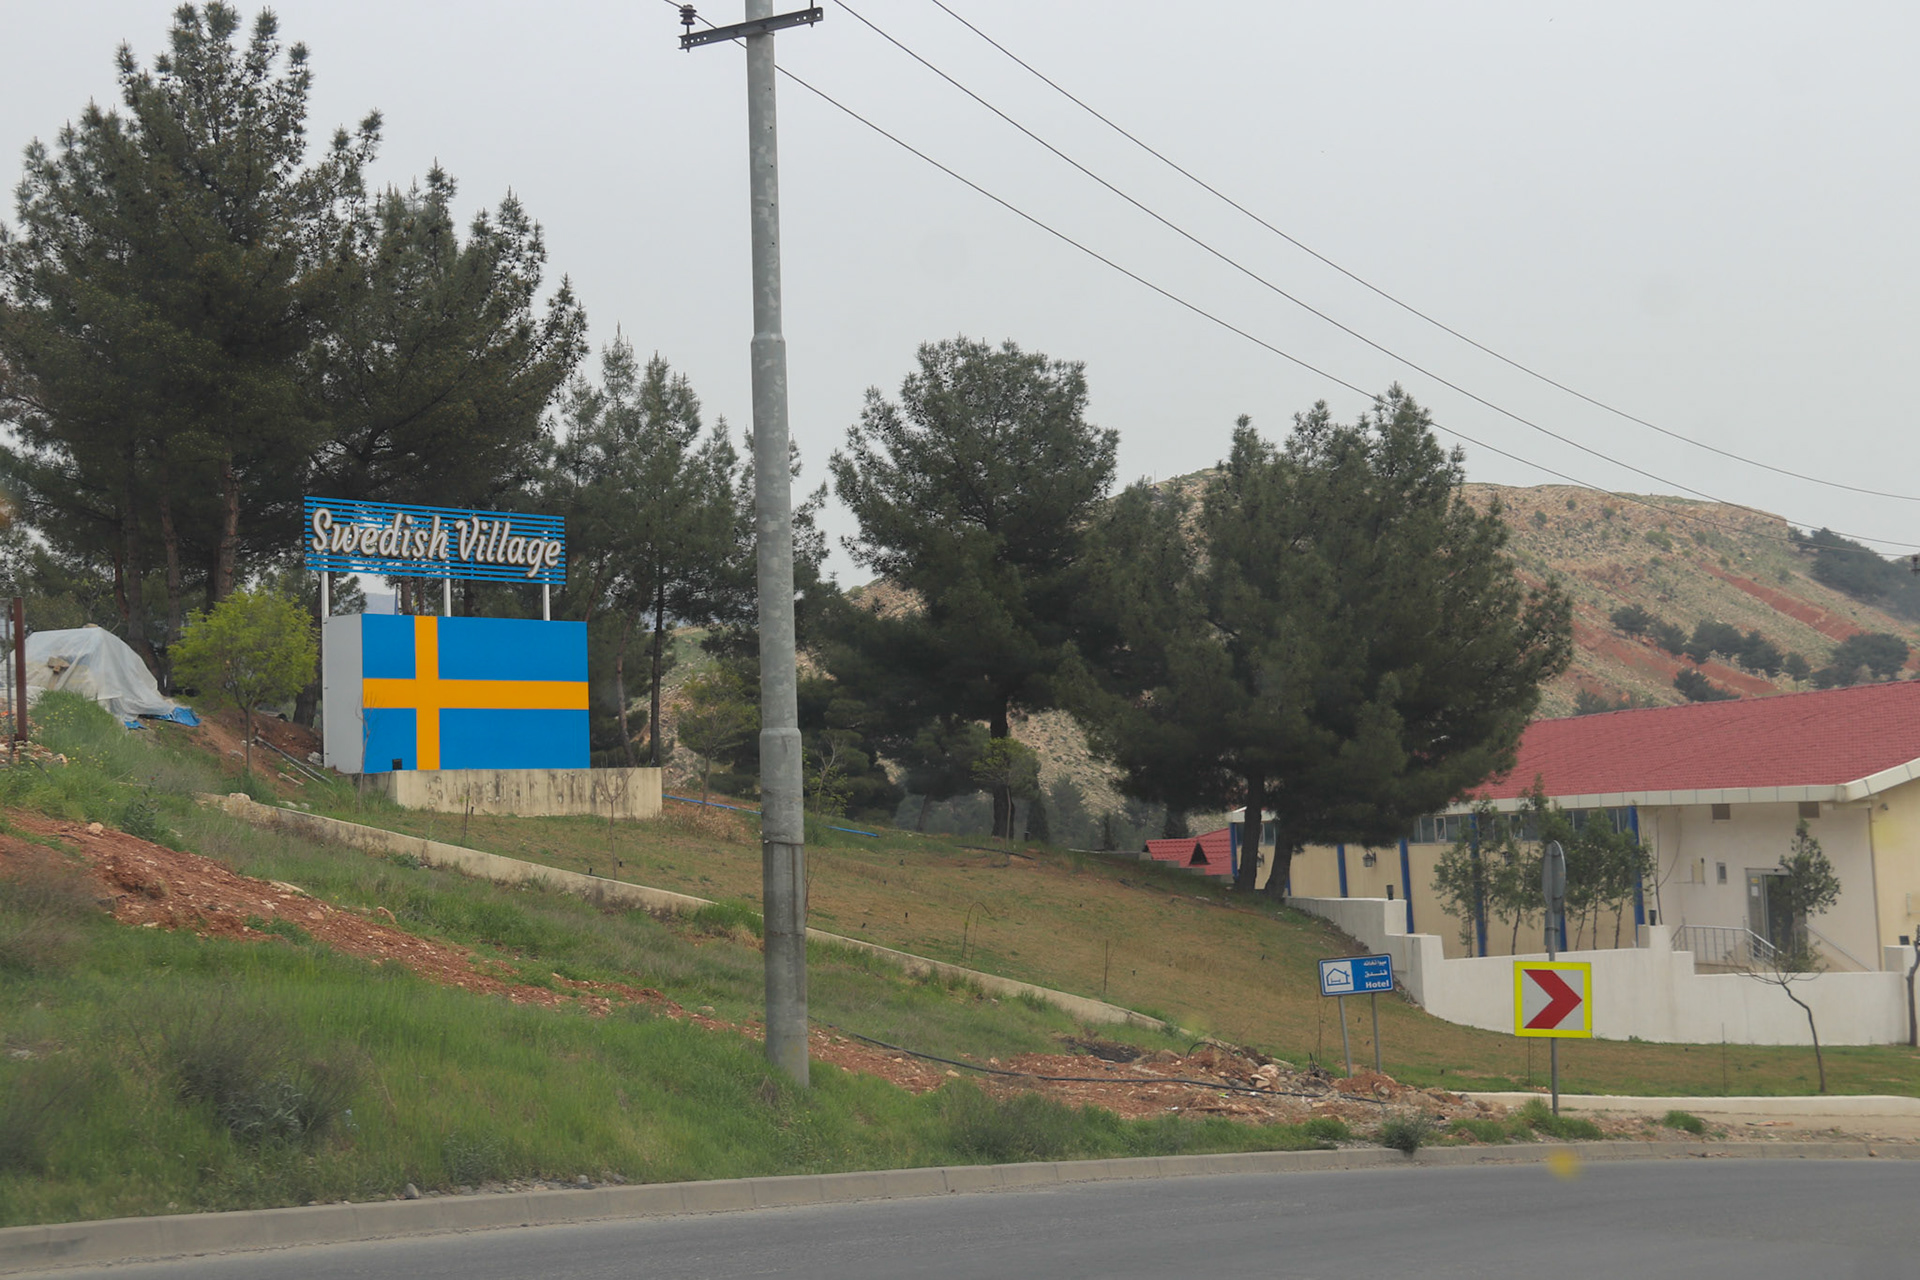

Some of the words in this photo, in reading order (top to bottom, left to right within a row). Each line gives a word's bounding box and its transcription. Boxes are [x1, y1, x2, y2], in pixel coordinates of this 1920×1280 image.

[311, 507, 450, 560] Swedish
[454, 516, 562, 578] Village
[1365, 979, 1389, 988] Hotel
